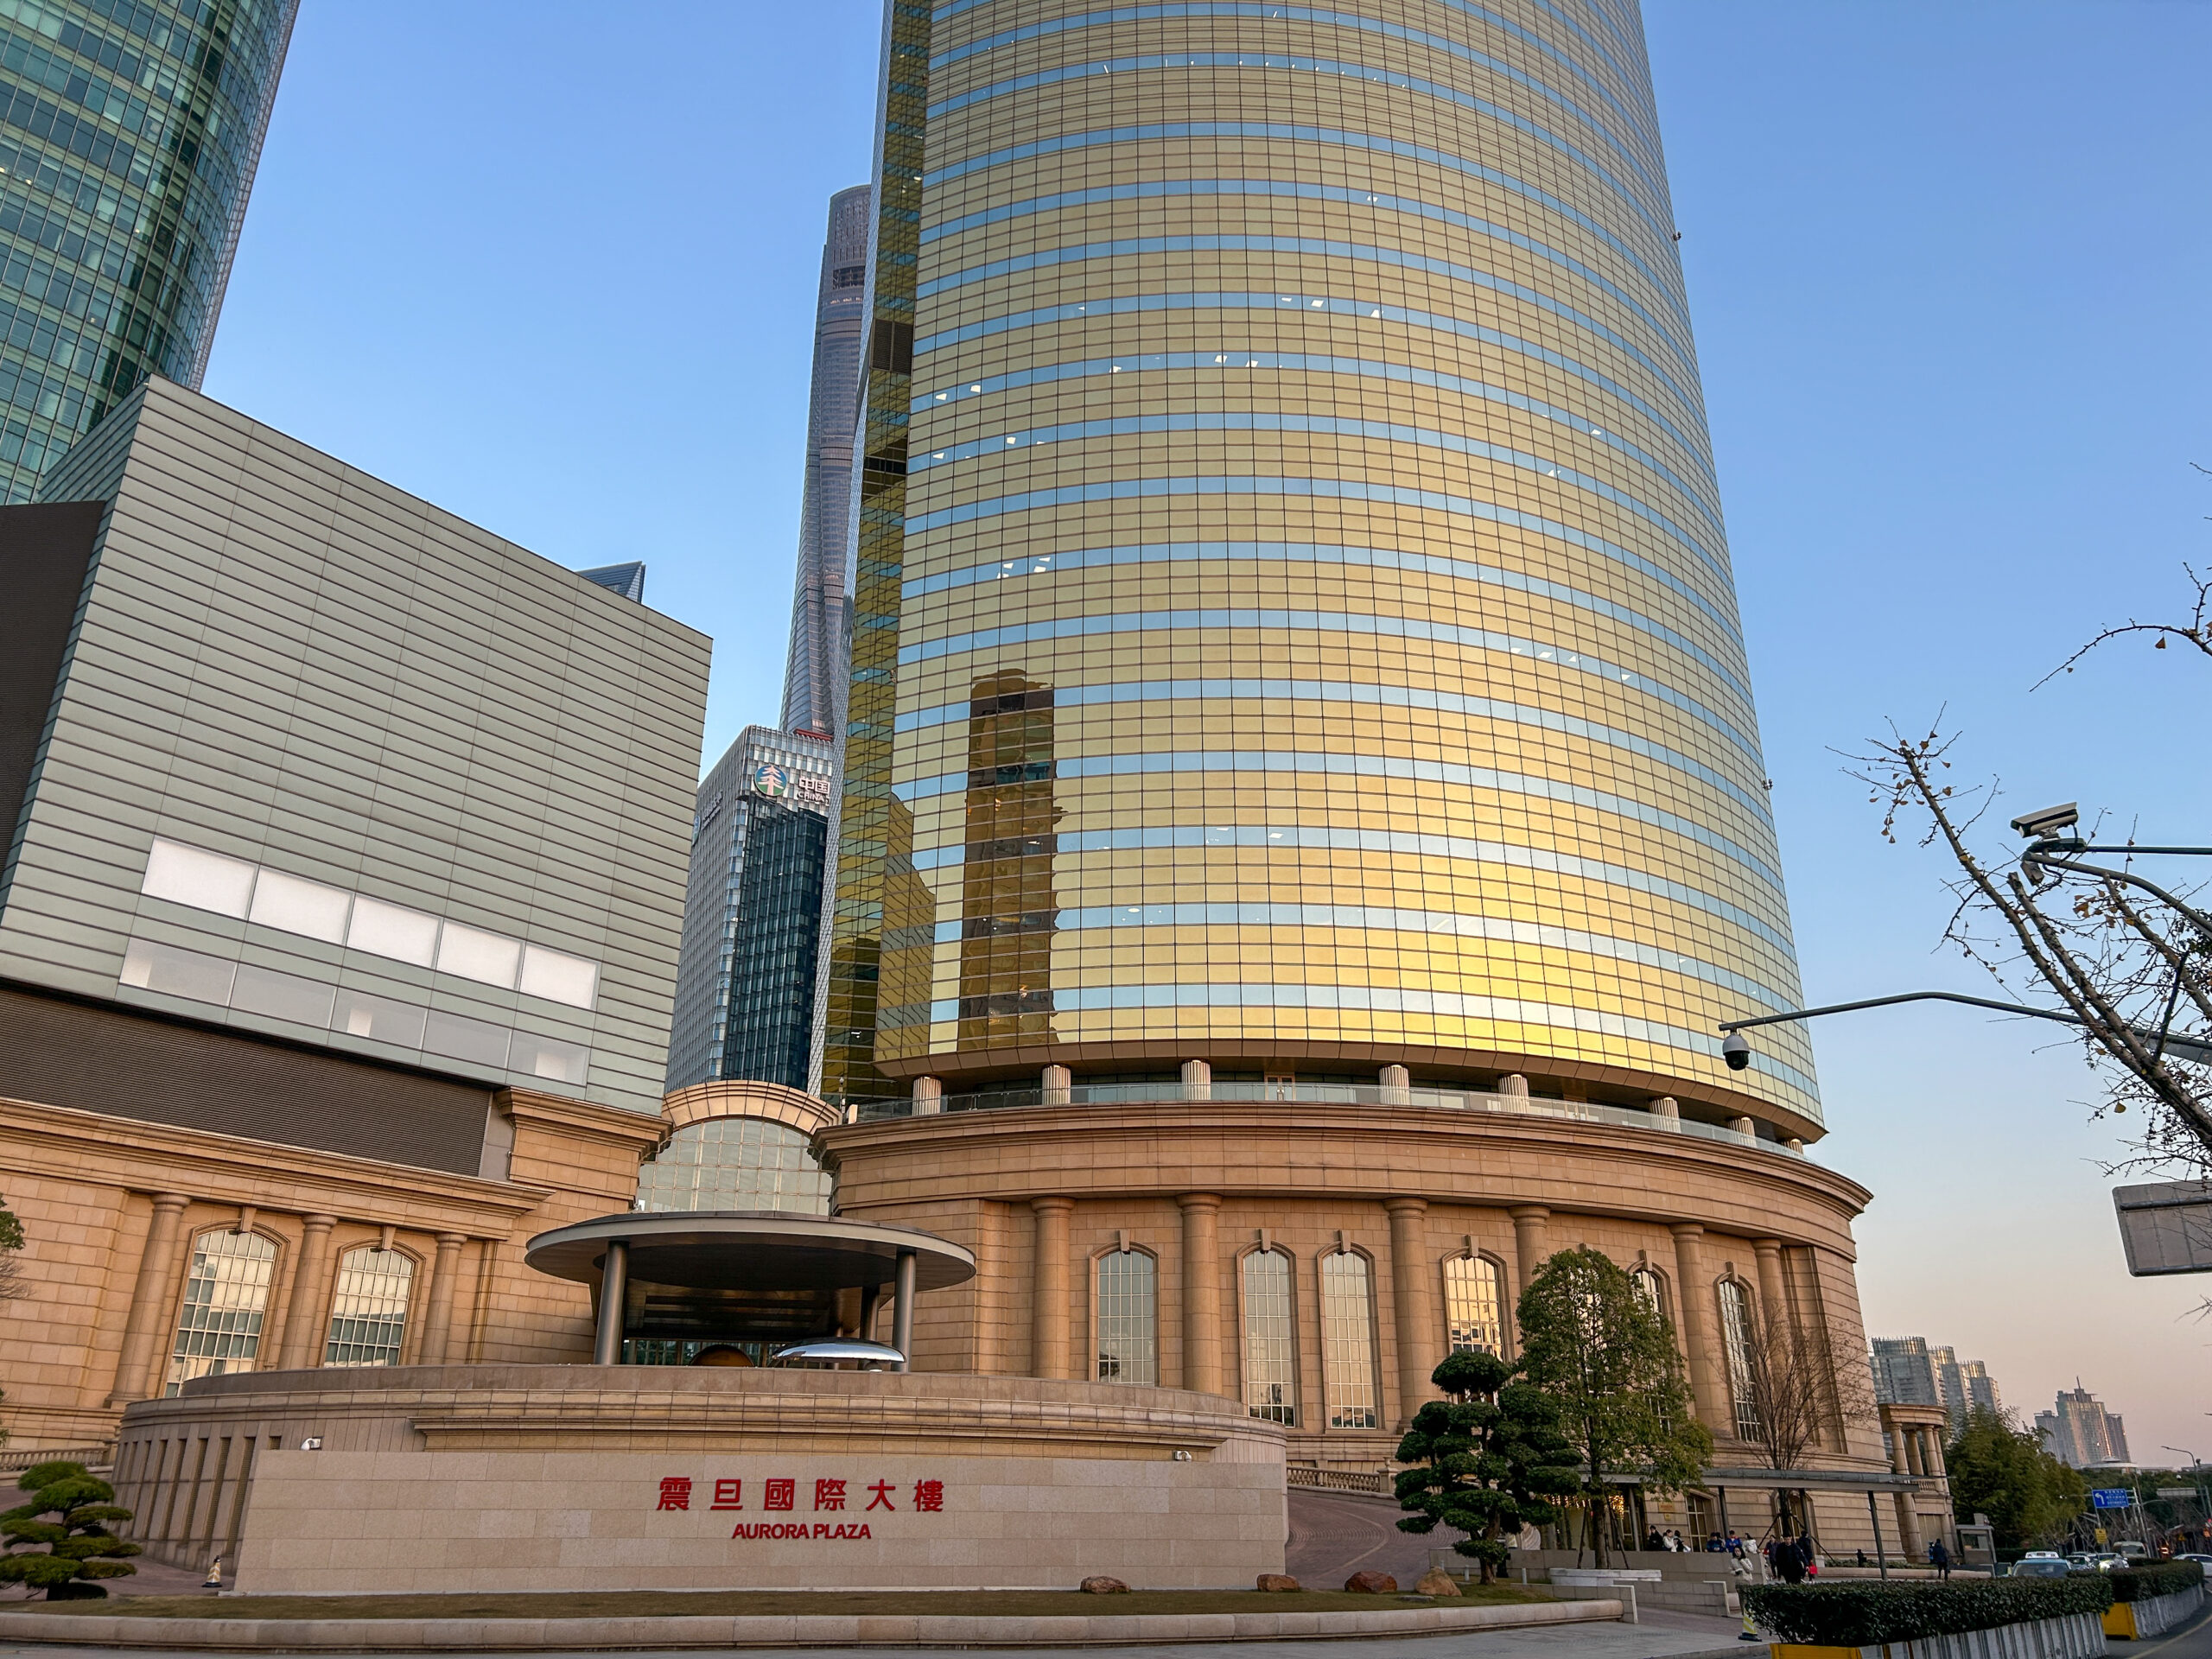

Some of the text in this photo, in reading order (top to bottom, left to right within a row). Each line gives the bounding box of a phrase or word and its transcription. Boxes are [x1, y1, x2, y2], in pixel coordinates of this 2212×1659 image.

[799, 777, 830, 795] 中国
[798, 791, 825, 803] CHINA
[656, 1477, 944, 1511] 震旦國際大樓
[732, 1523, 872, 1539] AURORA PLAZA
